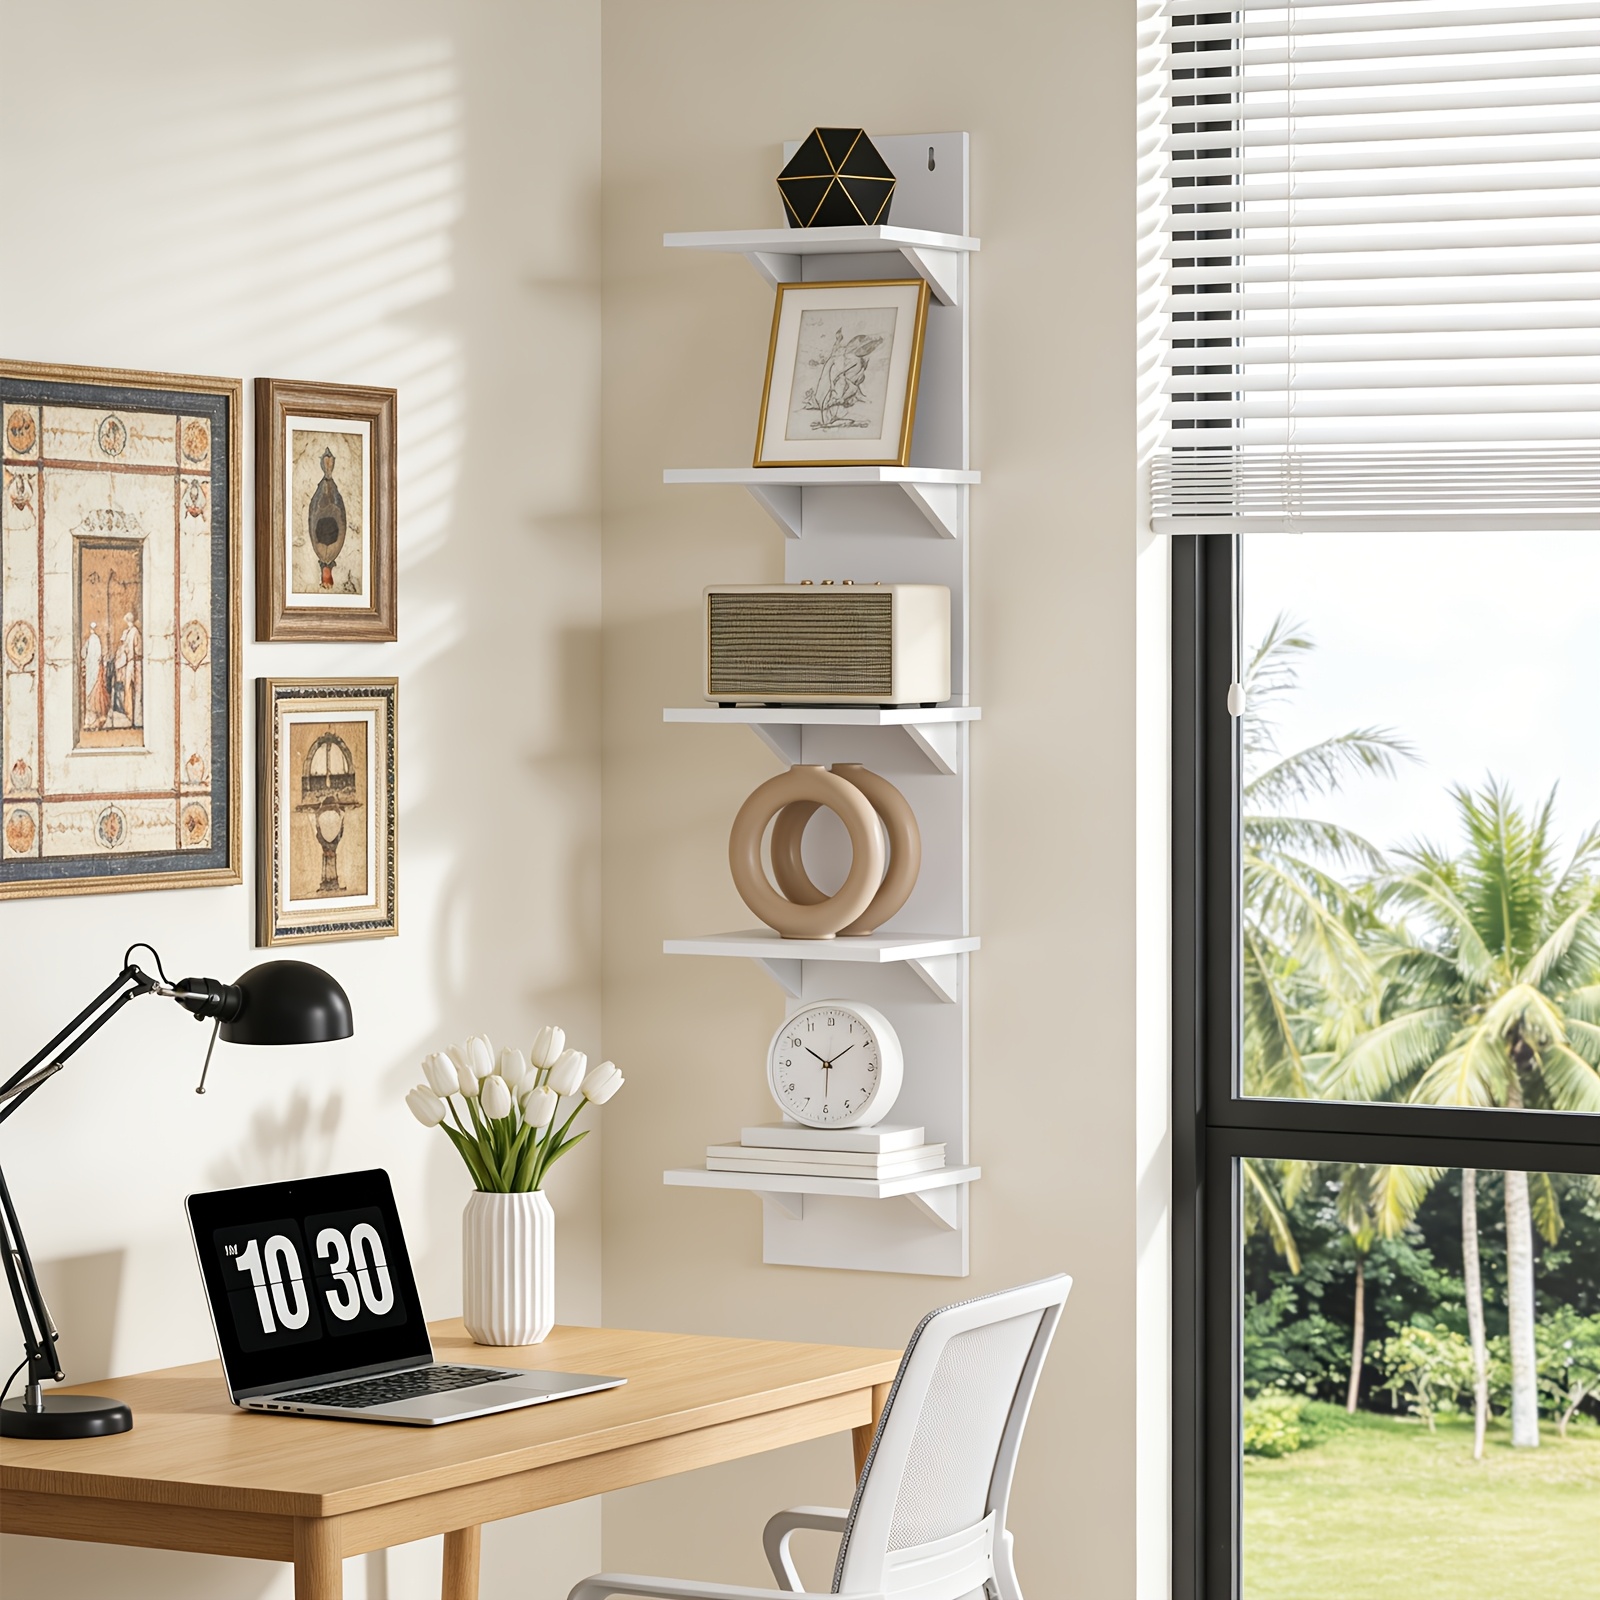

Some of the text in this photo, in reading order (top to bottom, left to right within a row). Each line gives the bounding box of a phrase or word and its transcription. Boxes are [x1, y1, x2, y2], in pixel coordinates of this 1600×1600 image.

[791, 1037, 802, 1048] 10
[235, 1234, 310, 1334] 10
[316, 1222, 395, 1321] 30
